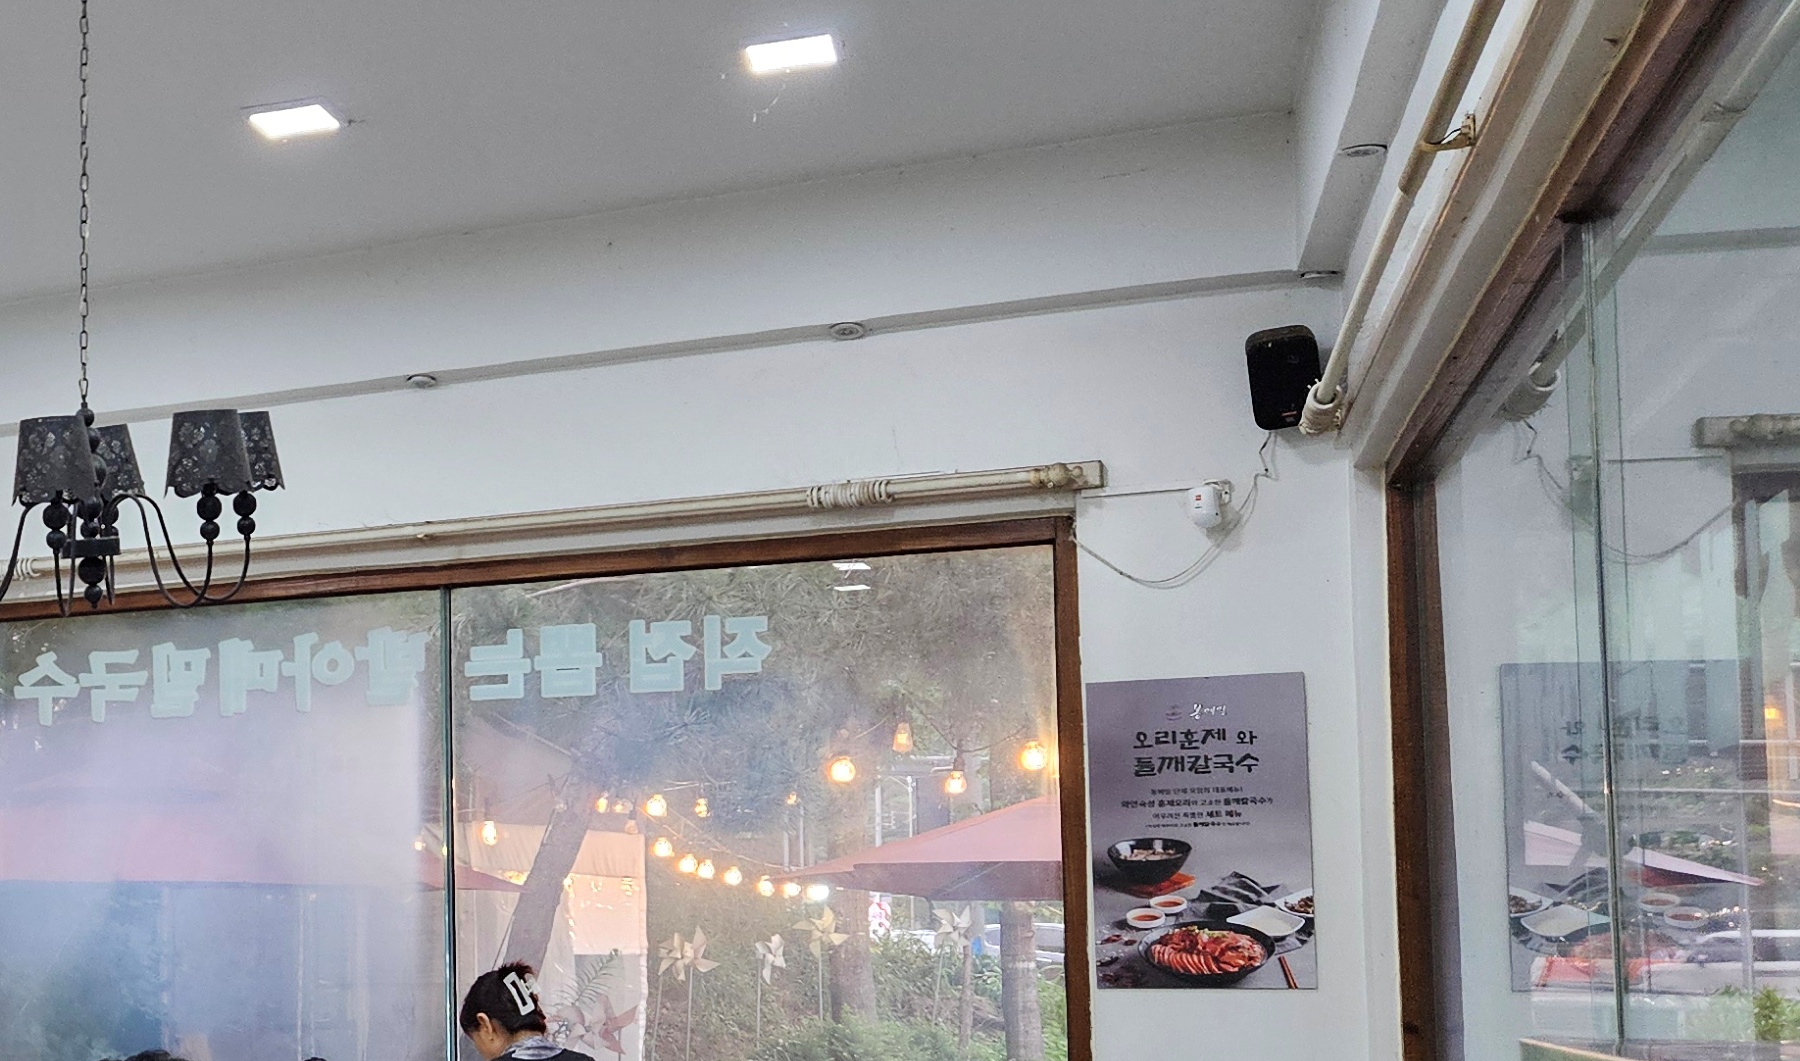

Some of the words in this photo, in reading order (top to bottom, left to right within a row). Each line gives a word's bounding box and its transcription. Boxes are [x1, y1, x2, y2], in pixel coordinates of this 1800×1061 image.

[1133, 728, 1227, 750] 오리훈제
[1236, 731, 1258, 746] 와
[1134, 753, 1260, 778] 들깨칼국수
